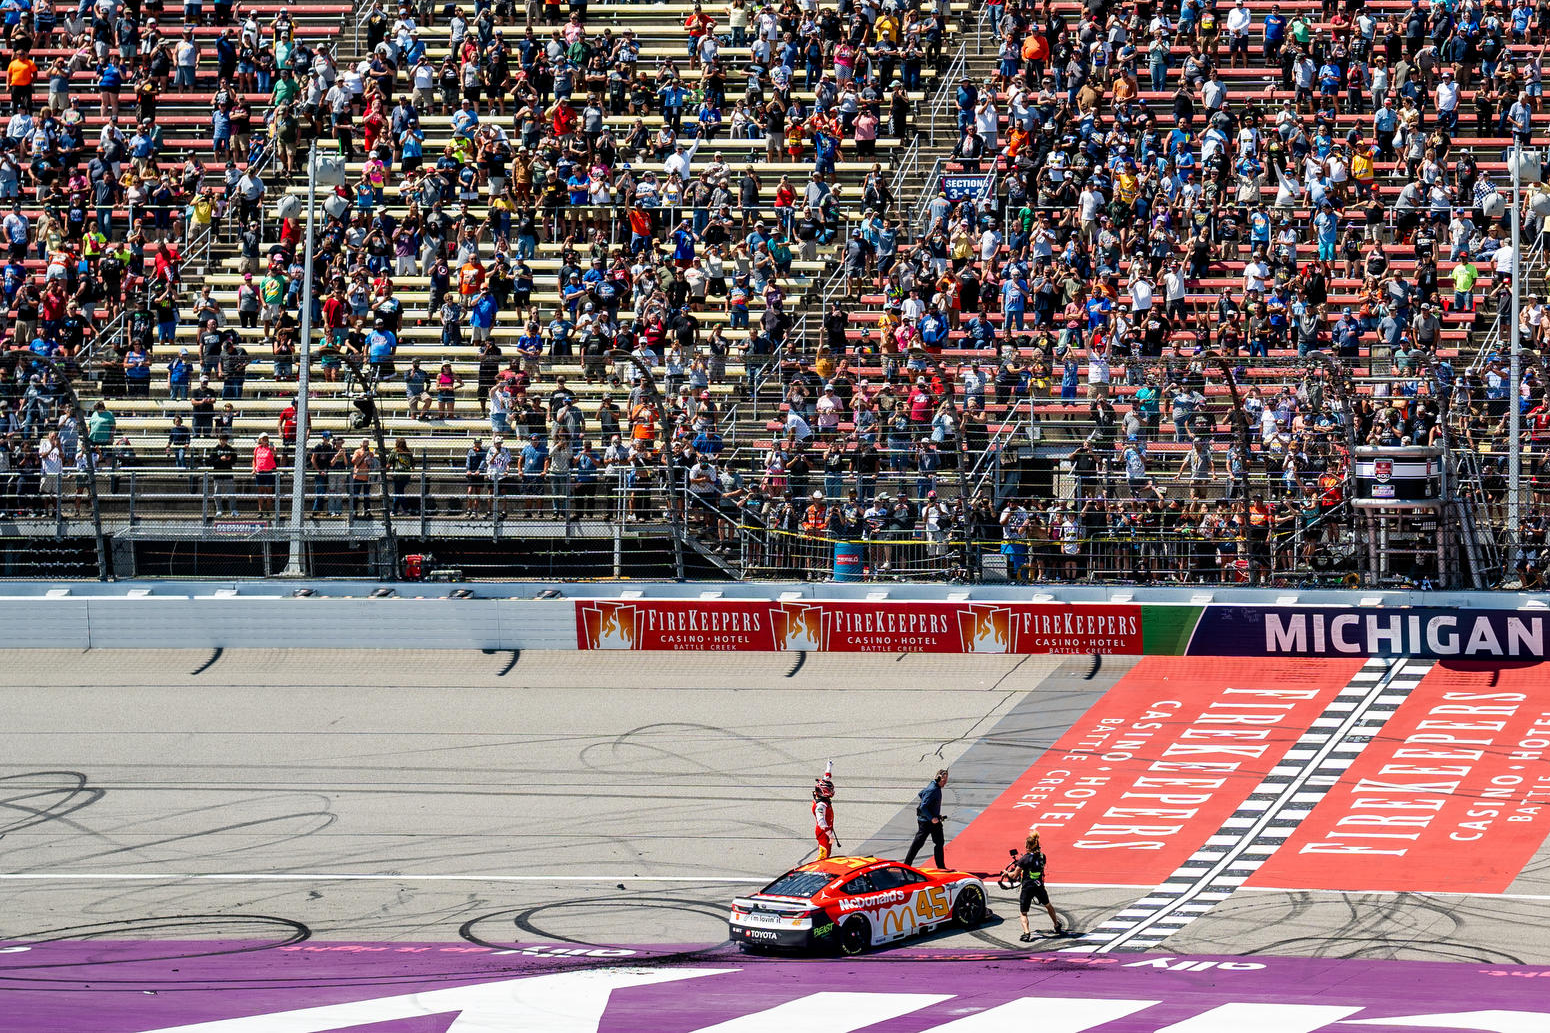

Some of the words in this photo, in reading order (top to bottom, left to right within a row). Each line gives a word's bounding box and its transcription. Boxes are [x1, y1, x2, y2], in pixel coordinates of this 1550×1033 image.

[946, 179, 989, 188] SECTIONS
[648, 609, 761, 632] FIREKEEPERS
[835, 610, 948, 634] FIREKEEPERS
[1023, 612, 1137, 636] FIREKEEPERS
[660, 635, 705, 643] CASINO
[714, 635, 750, 643] HOTEL
[847, 636, 892, 645] CASINO
[901, 636, 938, 645] HOTEL
[1035, 638, 1080, 647] CASINO
[1090, 638, 1126, 647] HOTEL
[1265, 613, 1544, 657] MICHIGAN
[1086, 647, 1112, 655] CREEK
[1063, 718, 1125, 762] BATTLE
[1101, 700, 1183, 763] CASINO
[1073, 687, 1321, 851] FIREKEEPERS
[1298, 691, 1527, 857] FIREKEEPERS
[1012, 769, 1071, 810] CREEK
[1030, 776, 1111, 830] HOTEL
[1449, 774, 1524, 842] CASINO
[839, 890, 905, 911] McDonald's
[916, 885, 950, 920] 45
[750, 930, 777, 940] TOYOTA
[1119, 957, 1268, 972] ally
